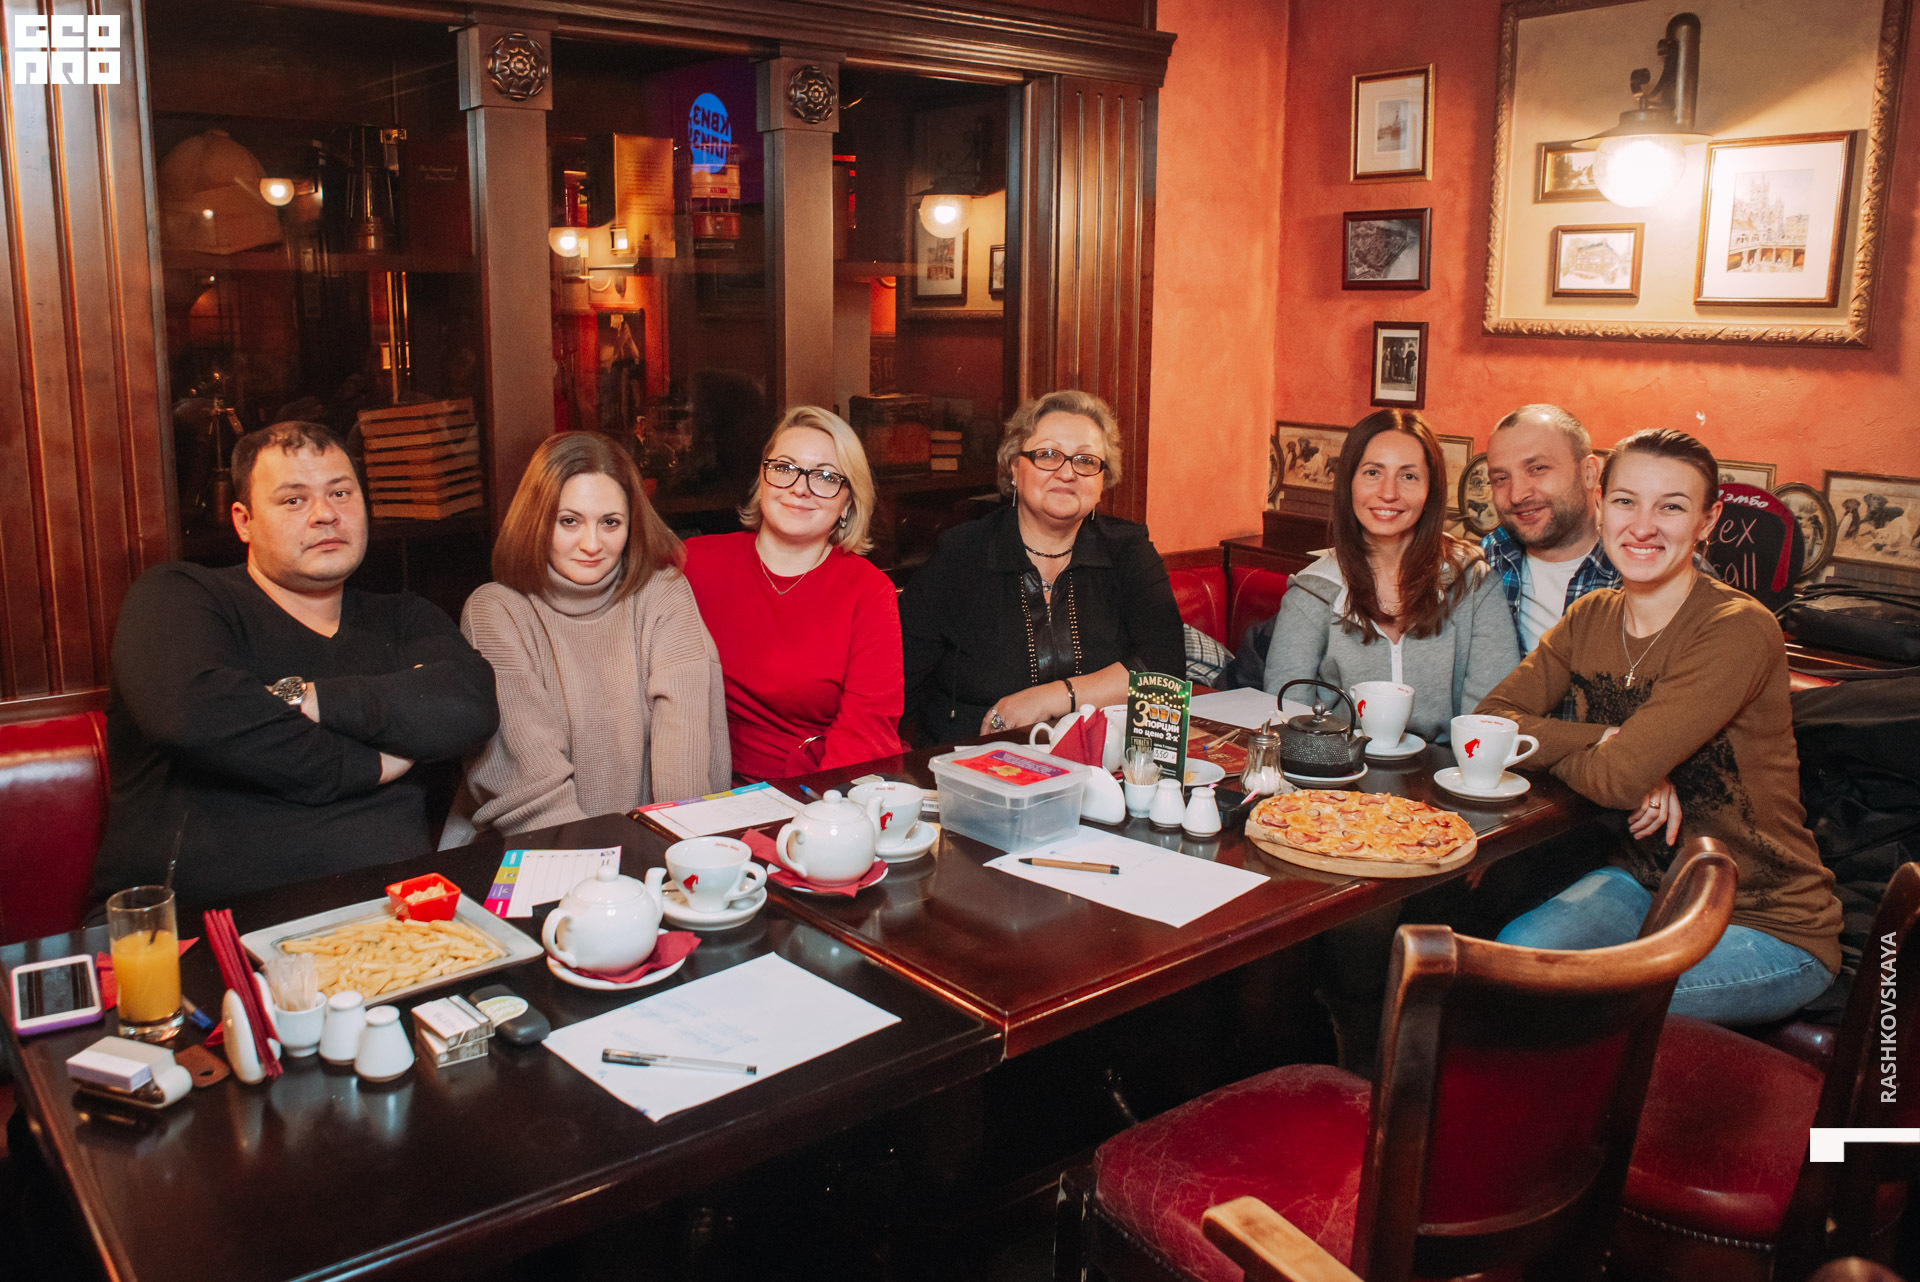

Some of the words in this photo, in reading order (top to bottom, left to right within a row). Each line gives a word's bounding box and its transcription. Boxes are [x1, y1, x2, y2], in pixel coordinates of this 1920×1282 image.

[1710, 518, 1757, 548] ex
[1137, 675, 1182, 693] JAMESON
[1132, 700, 1151, 727] 3
[1133, 727, 1144, 735] по
[1145, 719, 1180, 734] ПОРЦИИ
